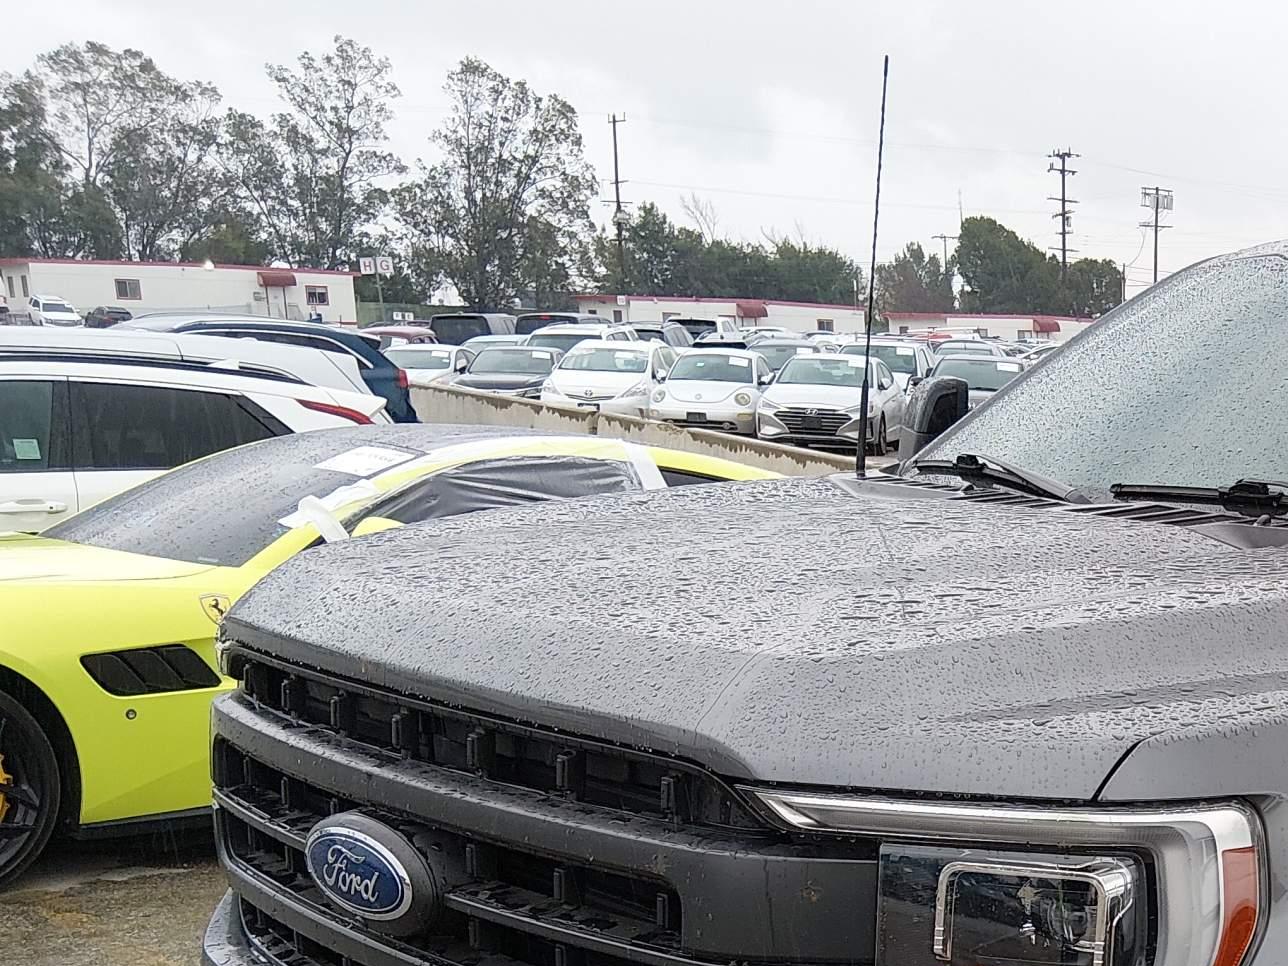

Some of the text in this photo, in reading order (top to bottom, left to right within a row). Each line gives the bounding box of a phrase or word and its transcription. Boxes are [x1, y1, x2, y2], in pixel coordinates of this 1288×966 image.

[363, 260, 390, 272] H G
[322, 844, 380, 903] Ford
